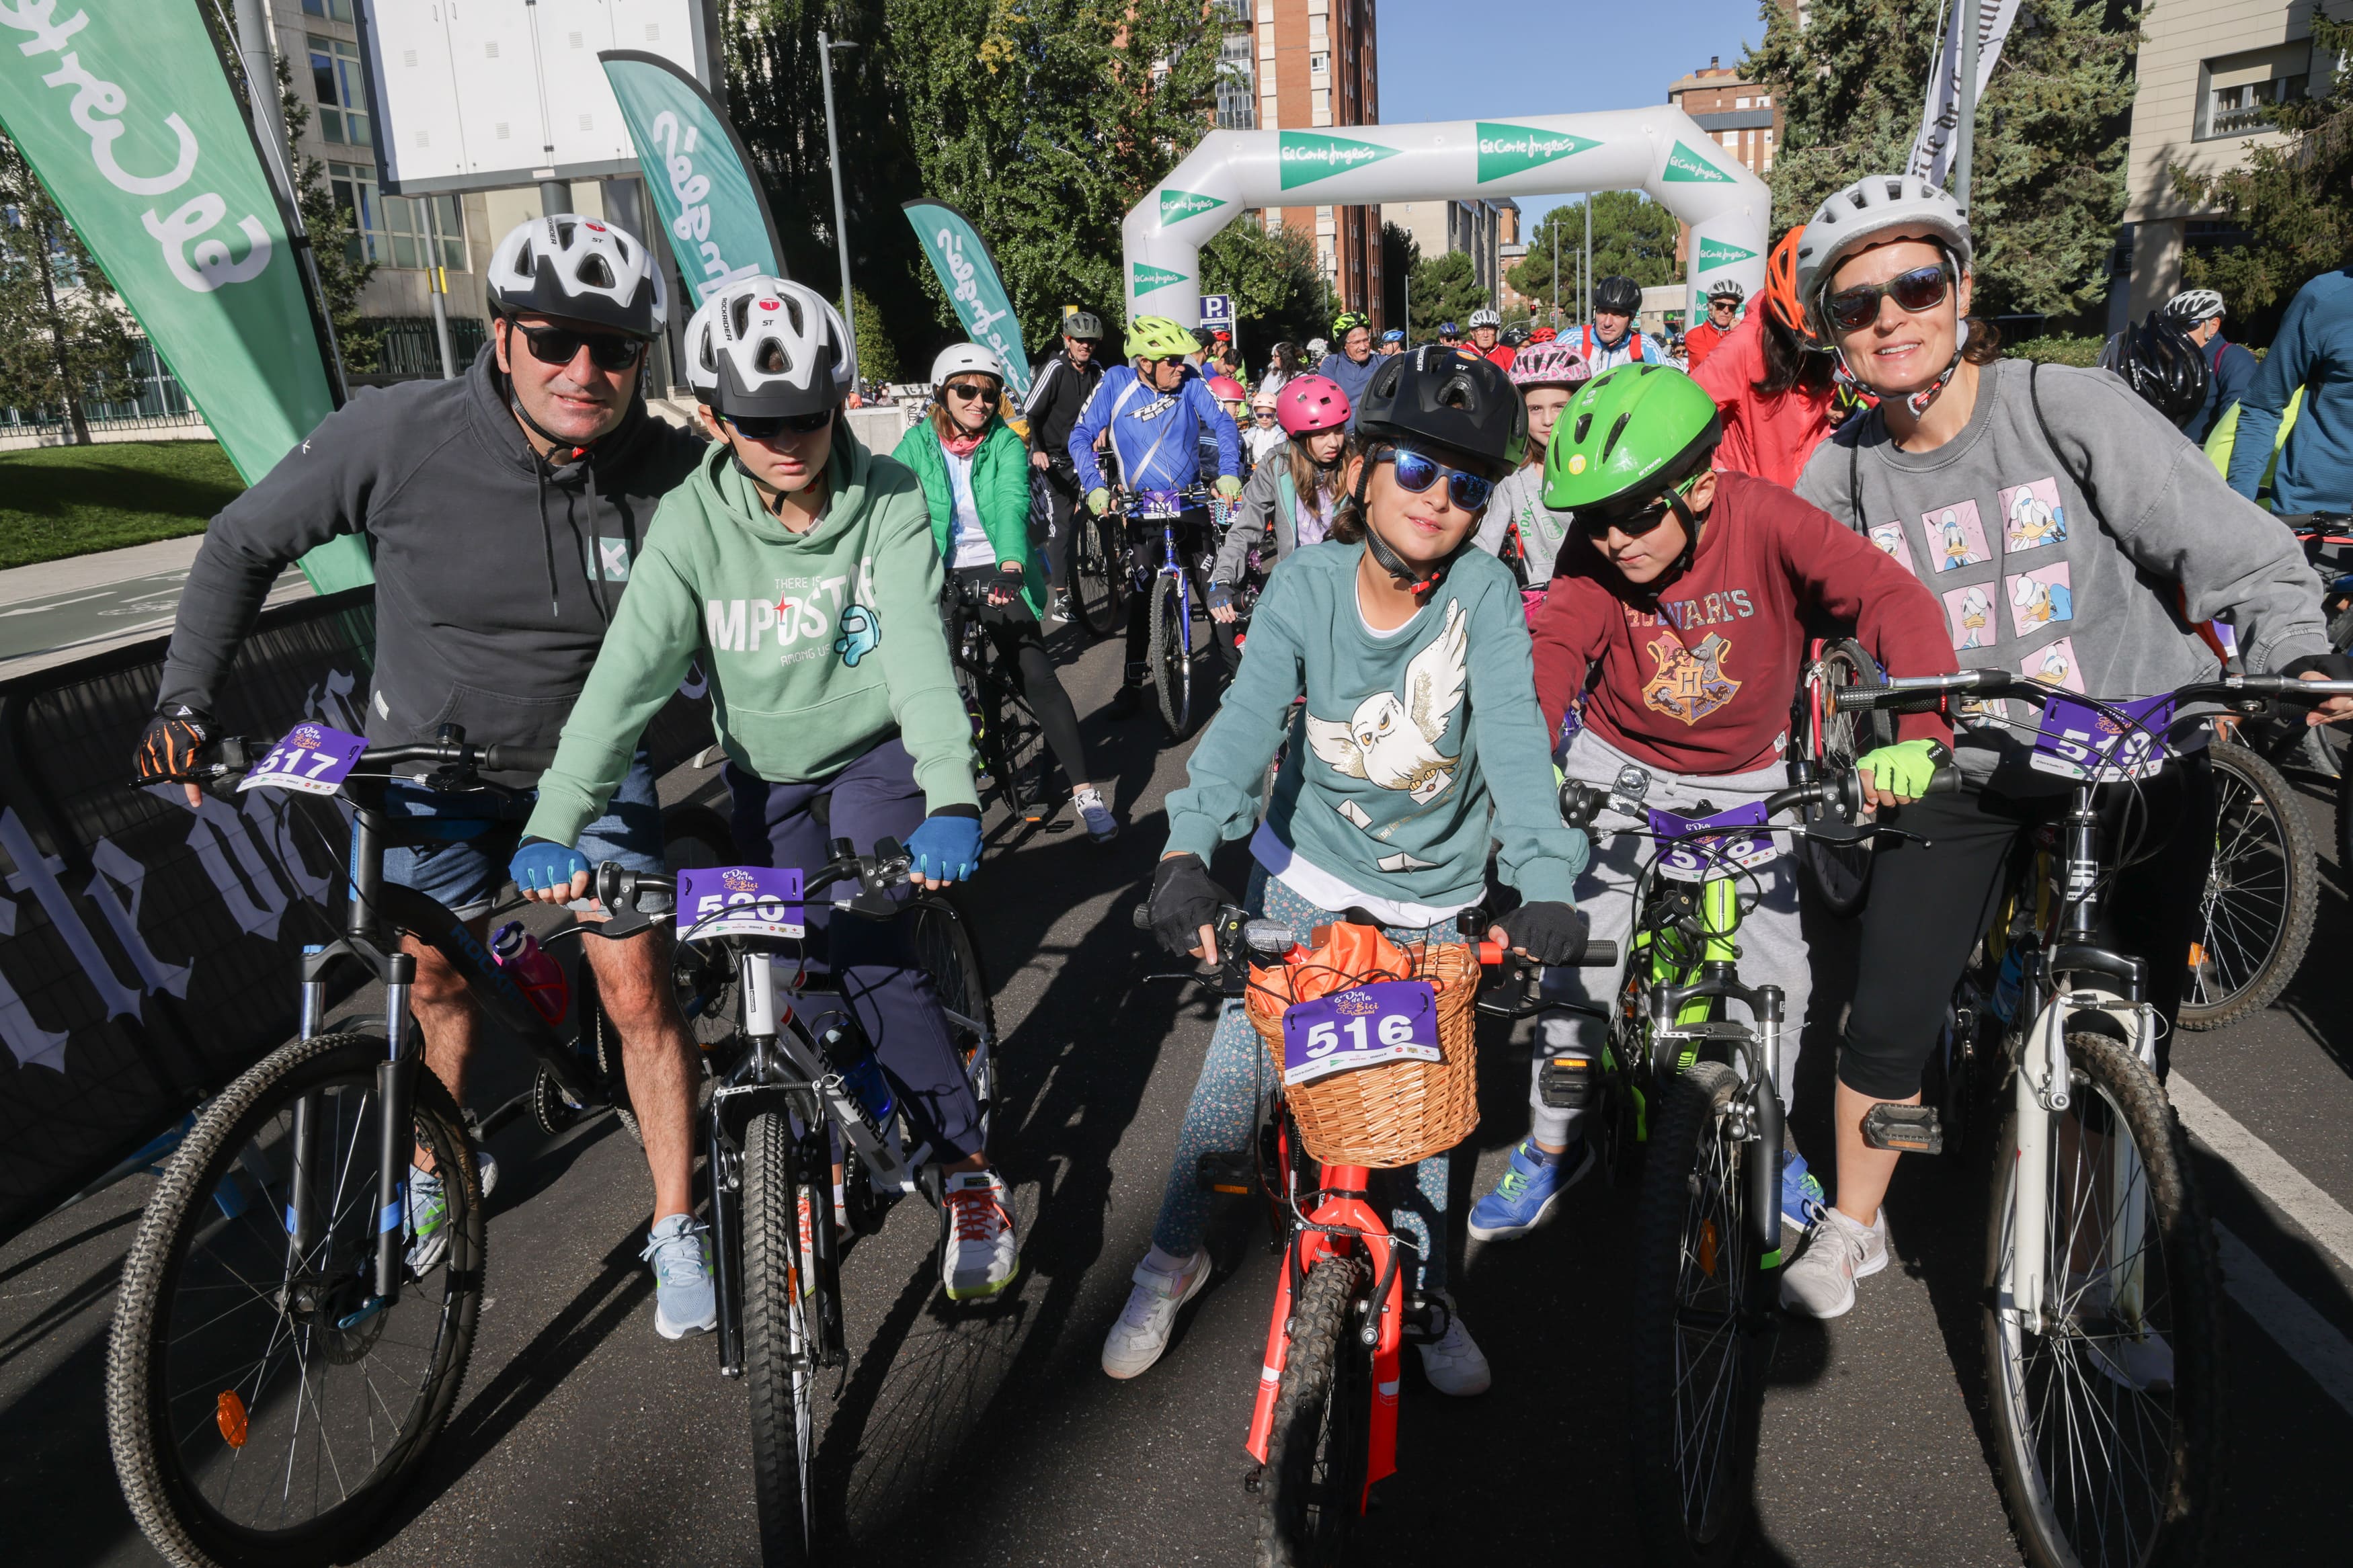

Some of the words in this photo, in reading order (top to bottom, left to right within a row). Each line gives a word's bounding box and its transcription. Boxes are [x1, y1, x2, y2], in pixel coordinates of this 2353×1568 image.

[1282, 147, 1296, 160] El
[1295, 146, 1328, 160] Corte
[1329, 142, 1375, 166] Inglés
[1480, 139, 1495, 154] El
[1494, 139, 1526, 153] Corte
[1527, 134, 1574, 158] Inglés
[1669, 156, 1679, 167] El
[1677, 159, 1696, 173] Corte
[1694, 161, 1723, 181] Inglés
[1168, 201, 1188, 210] Corte
[1707, 249, 1722, 259] Corte
[1140, 274, 1156, 283] Corte
[721, 297, 733, 341] ROCKRIDER
[1206, 297, 1222, 318] P
[774, 577, 807, 590] THERE
[781, 648, 815, 667] AMONG
[817, 644, 831, 657] US
[257, 747, 339, 779] 517
[739, 880, 759, 889] Bici
[695, 893, 785, 922] 520
[1354, 1002, 1379, 1012] Bici
[1306, 1014, 1413, 1059] 516
